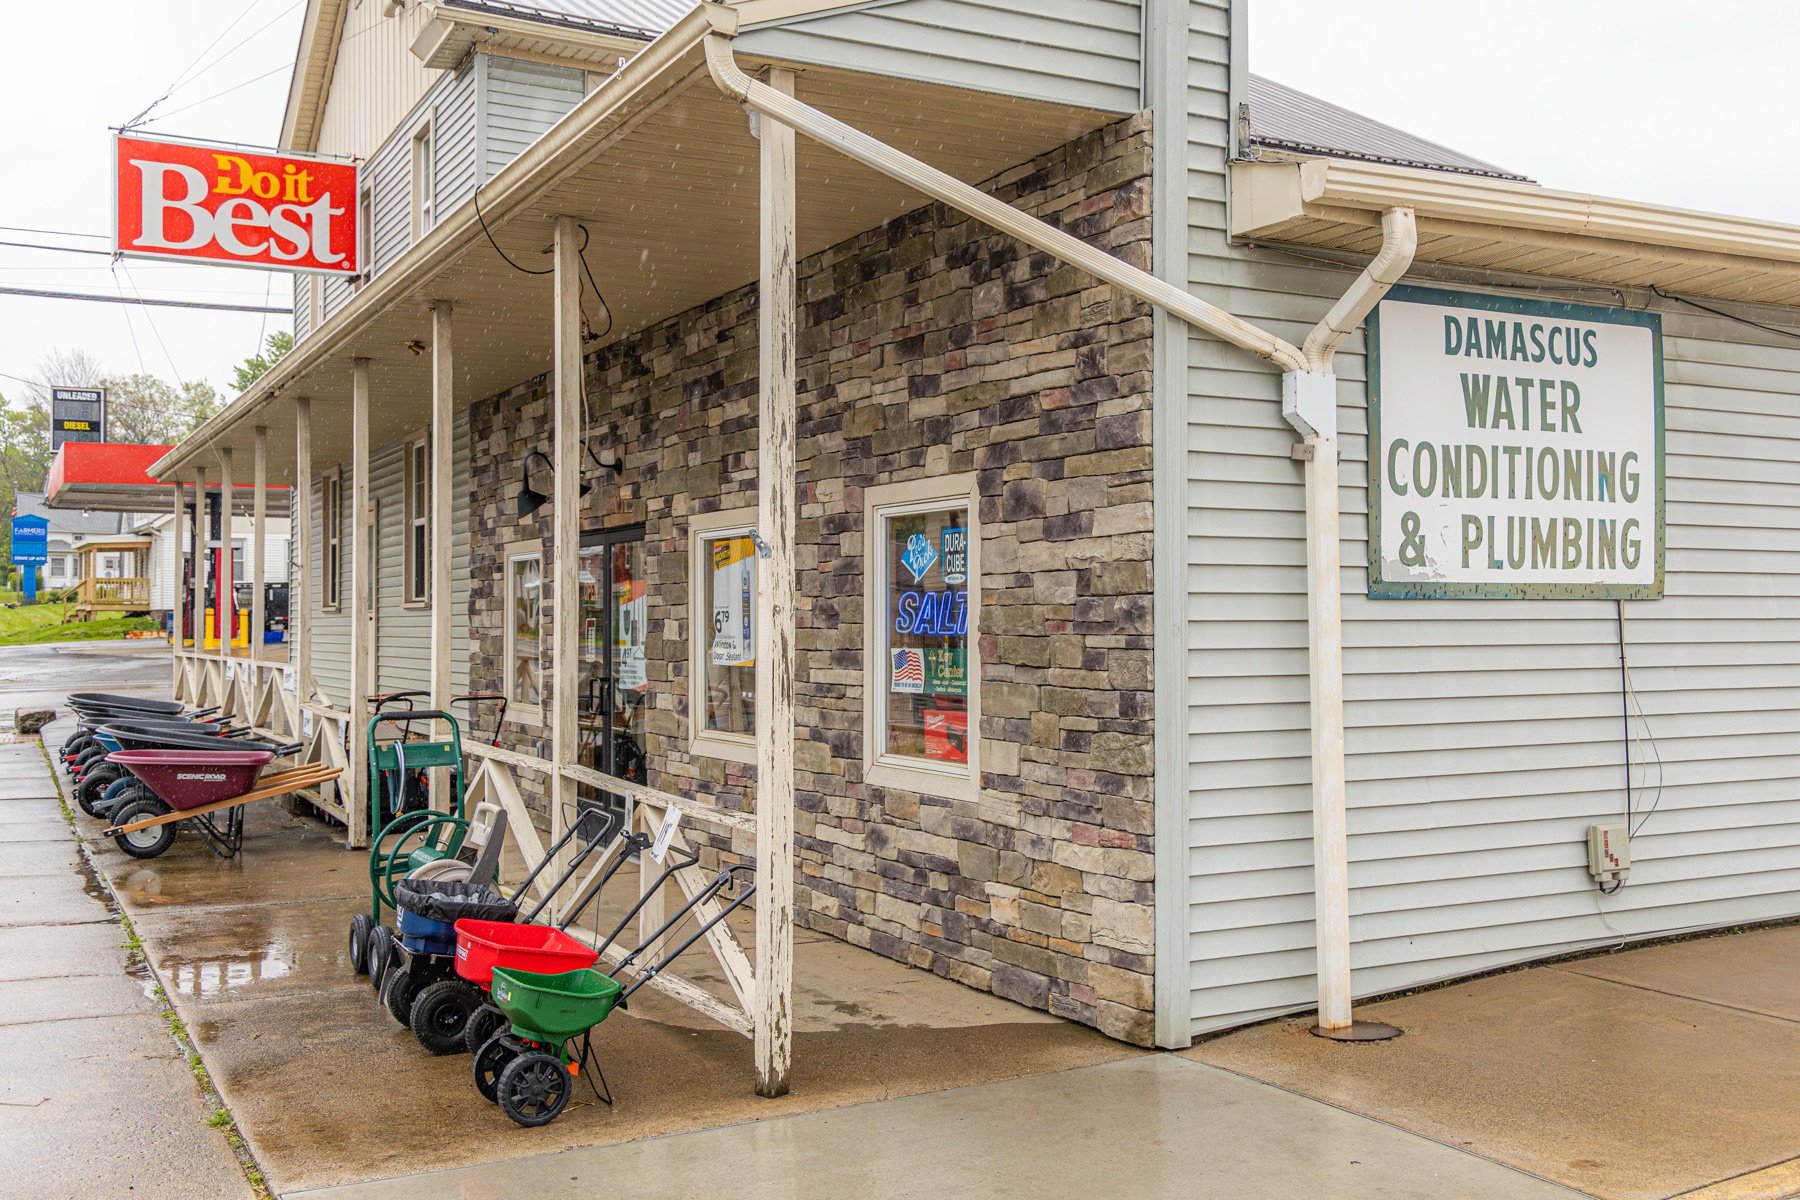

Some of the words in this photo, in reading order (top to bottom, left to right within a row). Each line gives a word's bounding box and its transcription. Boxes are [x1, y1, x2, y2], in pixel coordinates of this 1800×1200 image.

[212, 153, 281, 199] Do
[282, 163, 315, 203] it
[129, 158, 346, 264] Best
[1444, 314, 1598, 368] DAMASCUS
[57, 391, 97, 401] UNLEADED
[1459, 372, 1583, 434] WATER
[64, 421, 90, 431] DIESEL
[1387, 438, 1640, 503] CONDITIONING
[1398, 510, 1427, 568] &
[1461, 513, 1641, 570] PLUMBING
[946, 553, 965, 573] CUBE
[713, 640, 732, 649] Window
[713, 651, 725, 660] Door
[937, 649, 954, 666] Key
[937, 665, 965, 679] Center
